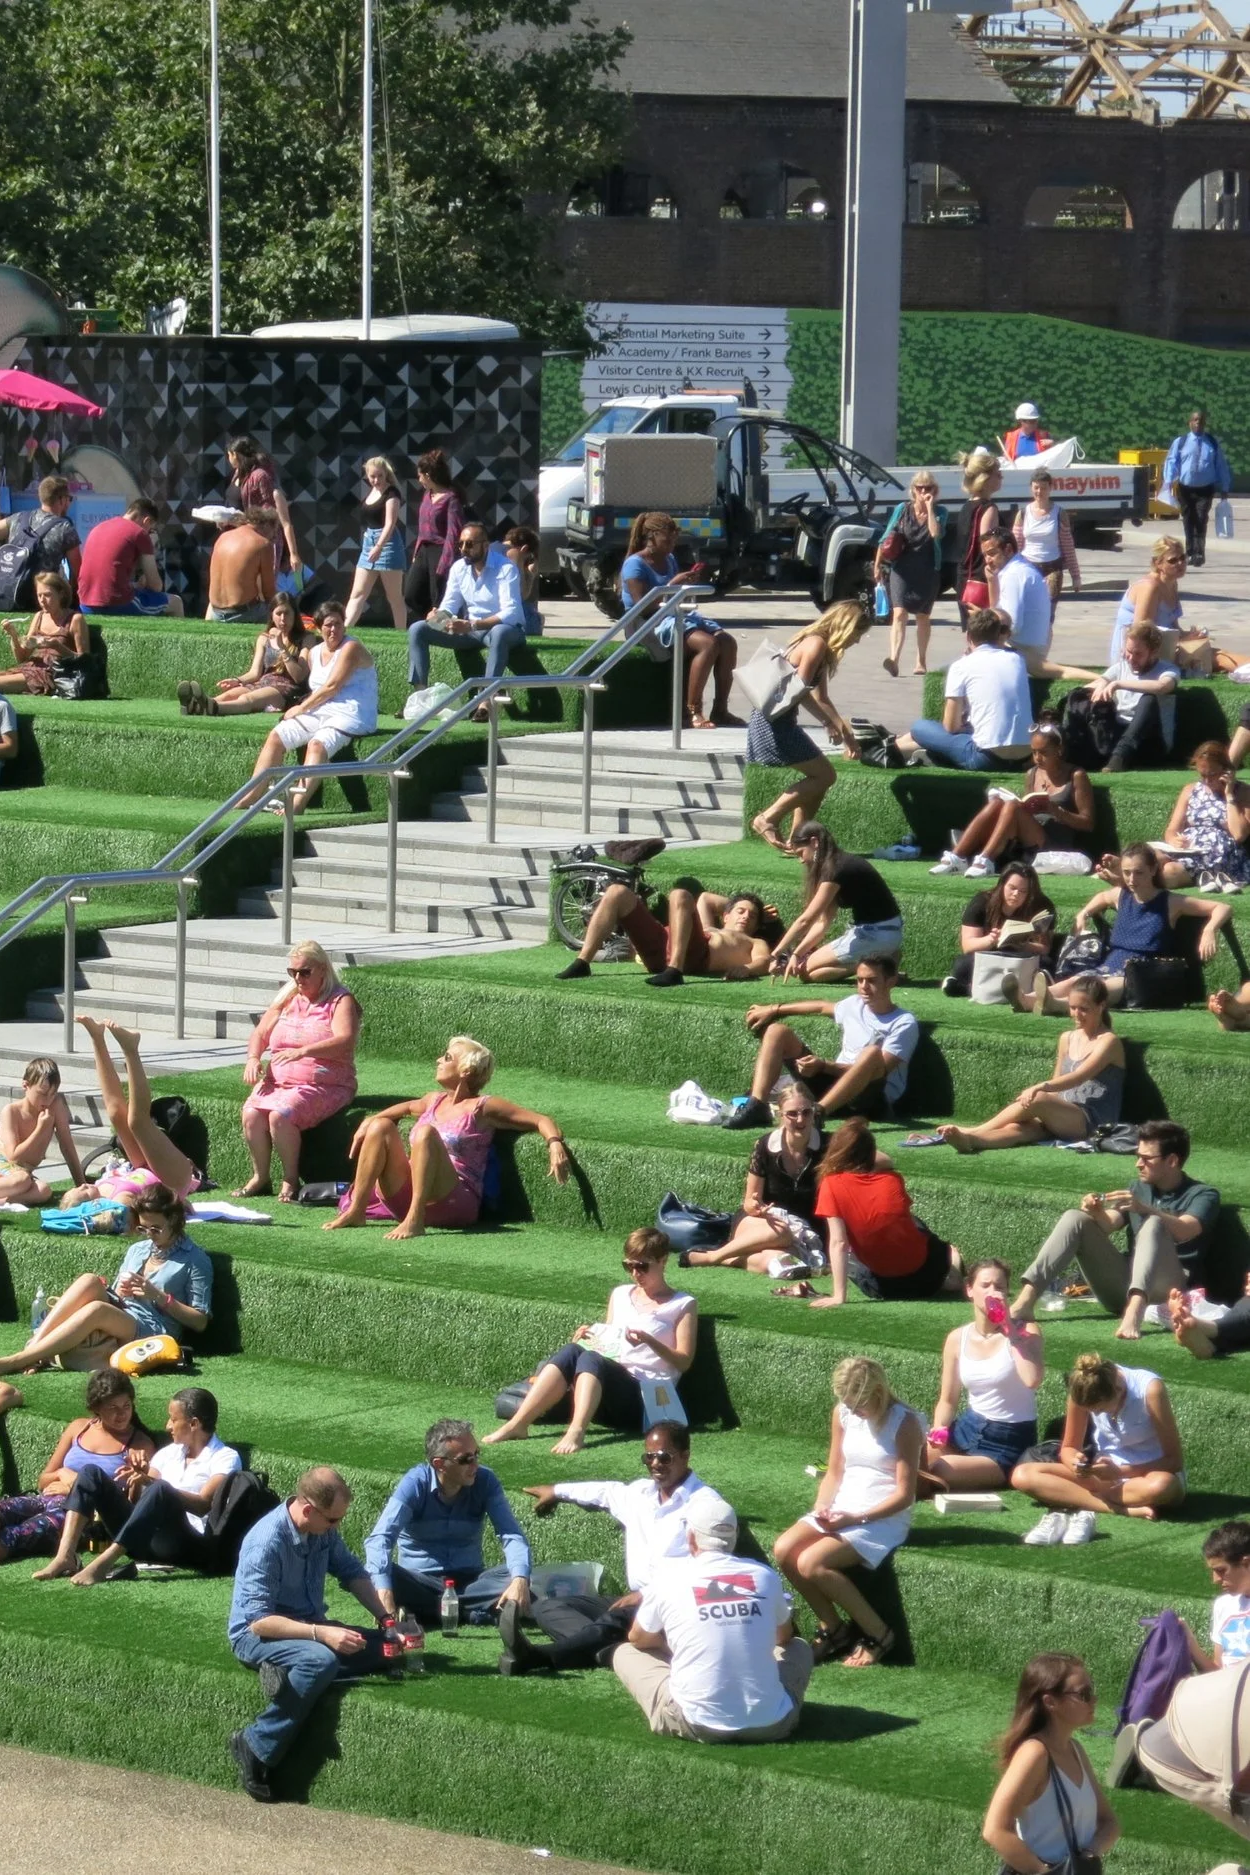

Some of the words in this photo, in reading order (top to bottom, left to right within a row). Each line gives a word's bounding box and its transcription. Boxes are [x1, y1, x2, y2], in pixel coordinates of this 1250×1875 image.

[598, 328, 658, 340] Rdential
[661, 330, 715, 341] Marketing
[718, 329, 746, 340] Suite
[618, 347, 670, 359] Academy
[681, 348, 712, 358] Frank
[715, 348, 752, 358] Barnes
[598, 365, 633, 376] Visitor
[636, 365, 673, 376] Centre
[675, 366, 683, 376] &
[687, 366, 703, 376] KX
[706, 367, 745, 377] Recruit
[599, 384, 630, 394] Lewis
[633, 384, 666, 394] Cubitt
[698, 1601, 762, 1621] SCUBA
